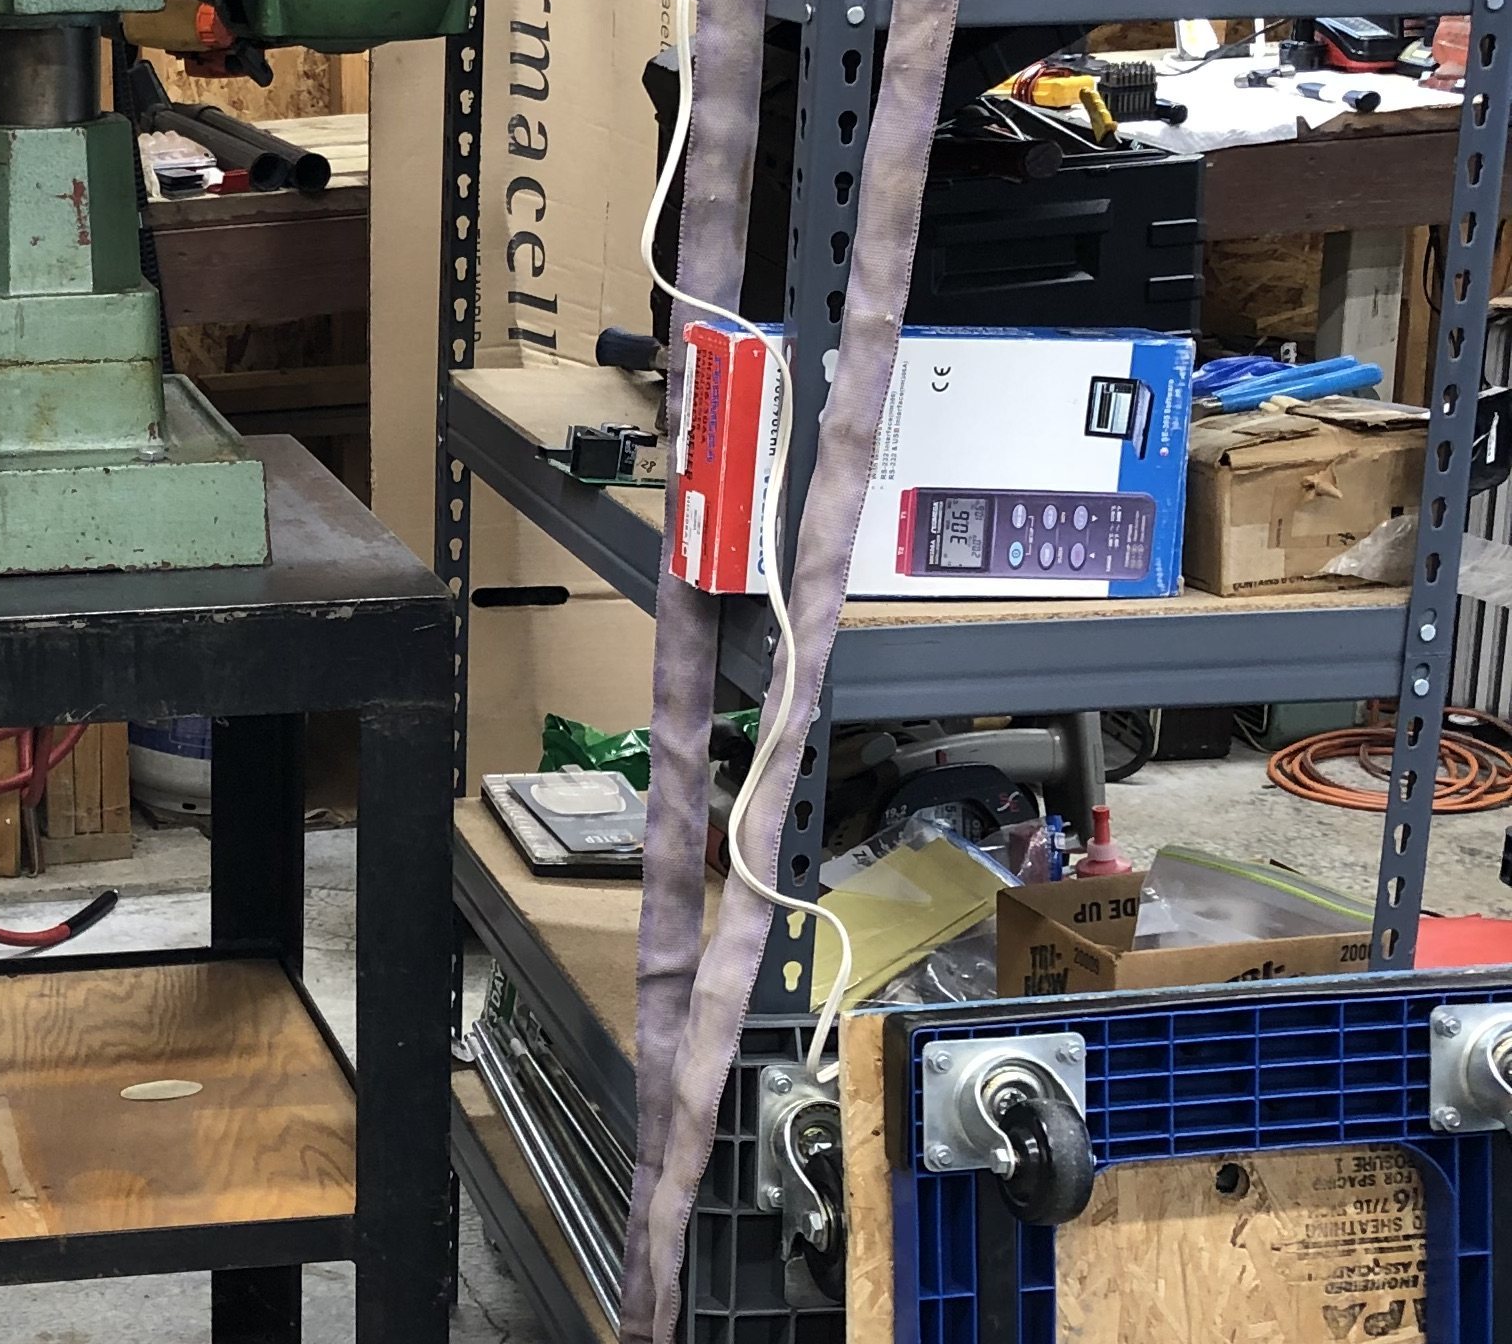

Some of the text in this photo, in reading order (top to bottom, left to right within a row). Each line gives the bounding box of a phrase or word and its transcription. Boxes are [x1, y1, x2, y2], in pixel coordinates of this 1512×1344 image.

[892, 427, 900, 444] USB
[880, 453, 889, 480] RS-232
[888, 452, 897, 480] RS-232
[898, 546, 904, 555] T2
[1074, 902, 1102, 923] UP
[1384, 1173, 1412, 1185] FOR
[1353, 1198, 1391, 1214] 7/16
